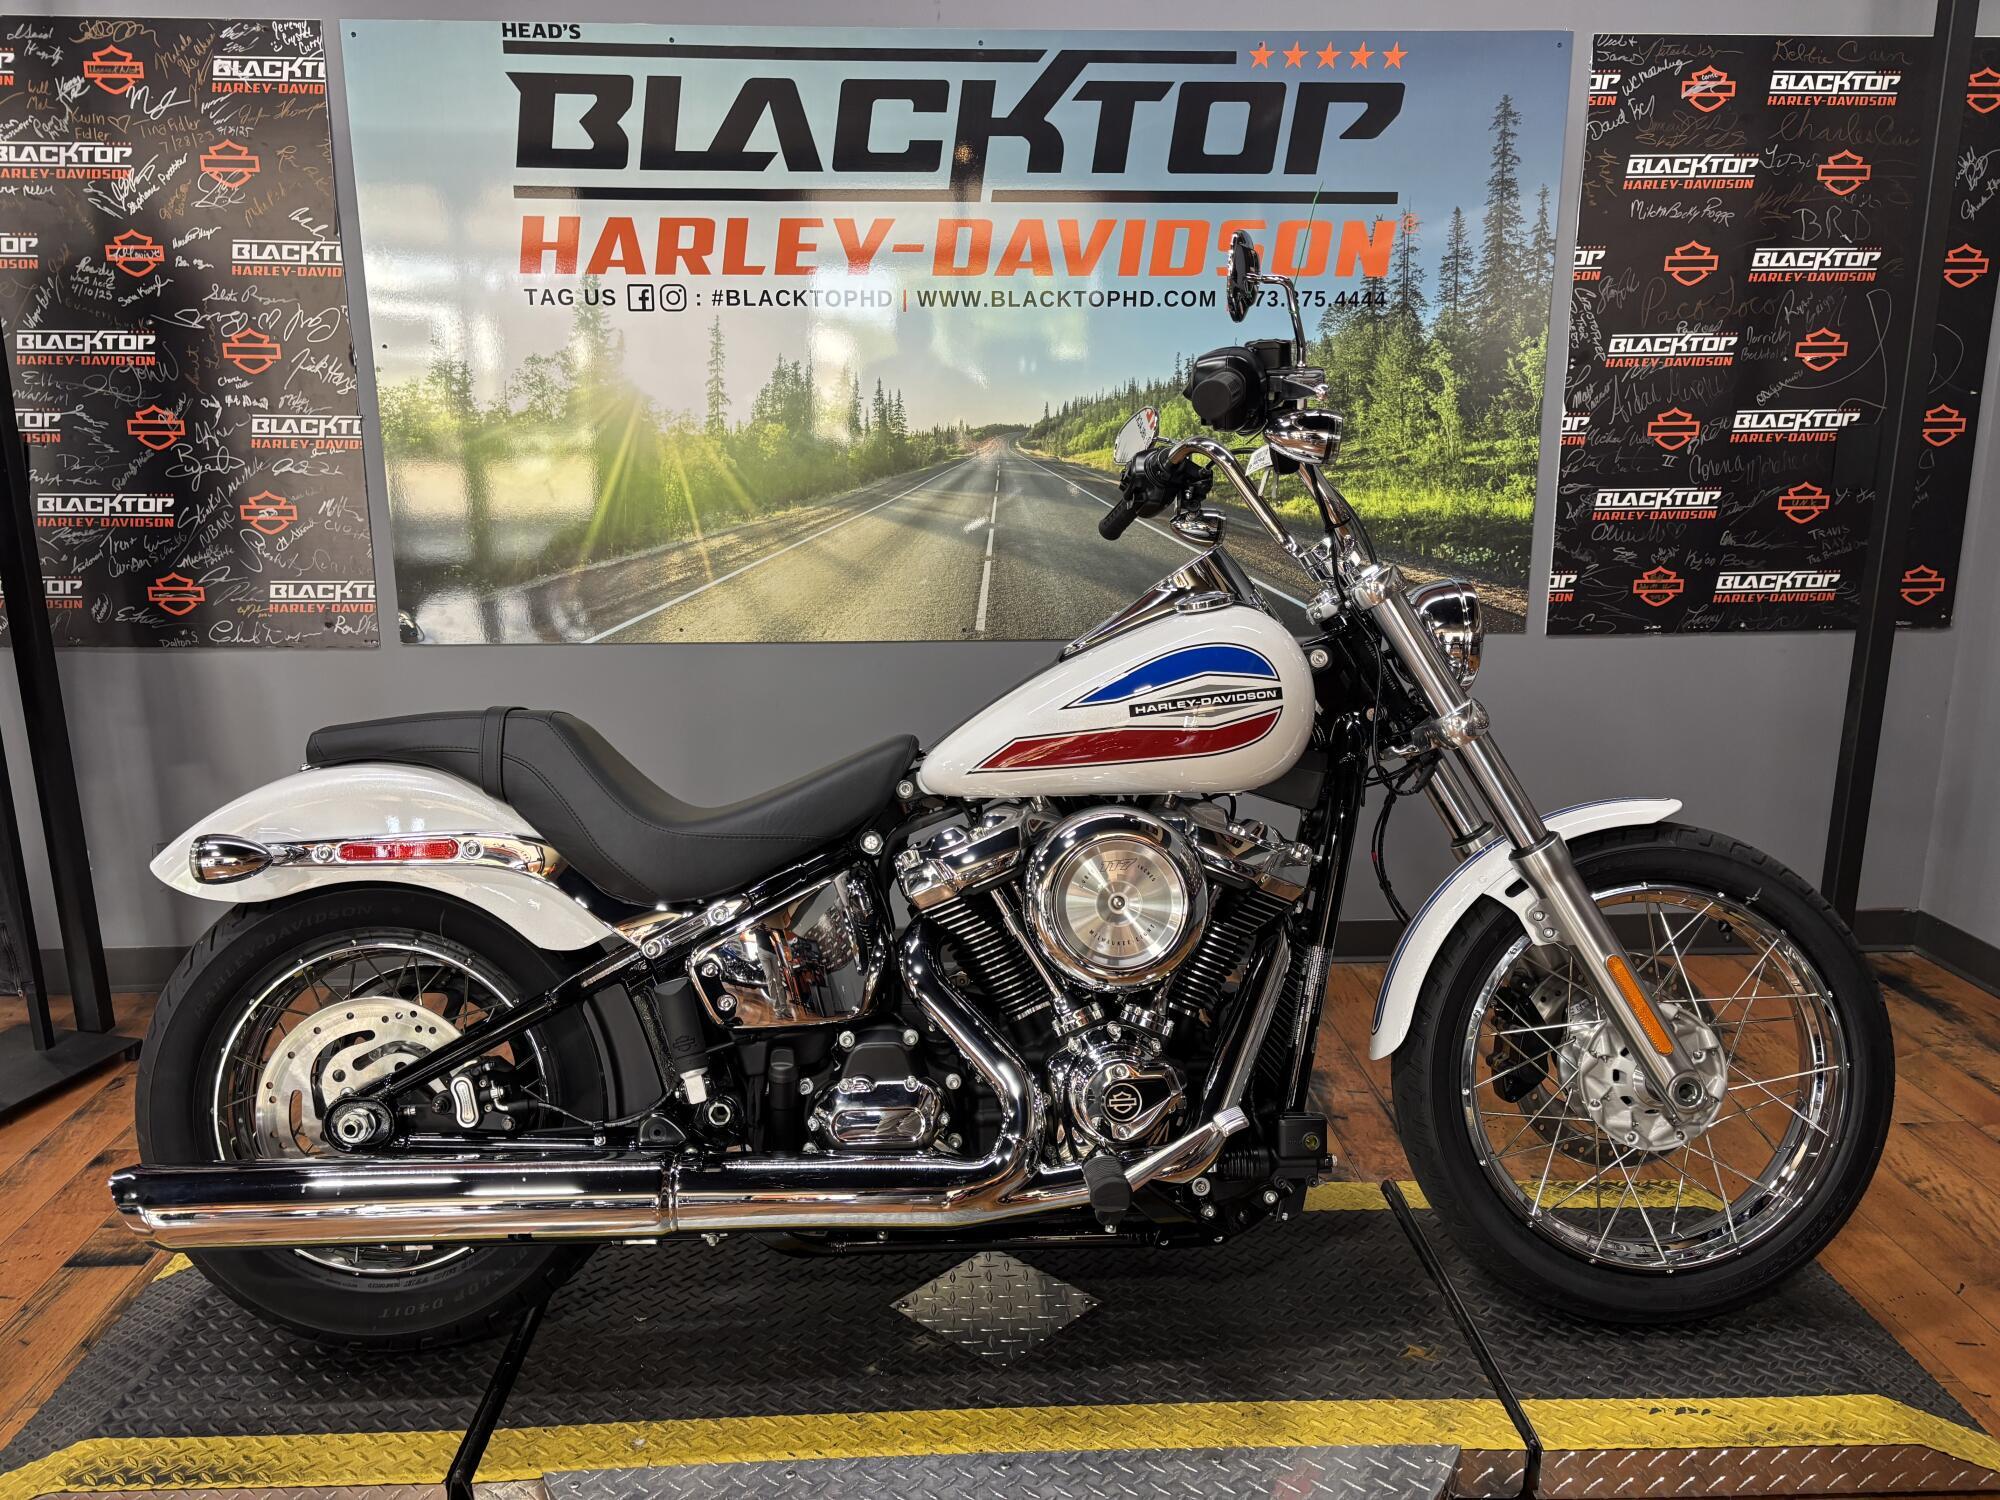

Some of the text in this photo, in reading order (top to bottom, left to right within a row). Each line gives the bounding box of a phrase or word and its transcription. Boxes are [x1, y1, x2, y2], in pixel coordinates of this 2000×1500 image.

[502, 22, 581, 40] HEAD'S
[212, 57, 326, 81] BLACKT
[1770, 71, 1901, 94] BLACKTOP
[1767, 96, 1897, 106] HARLEY-DAVIDSON
[505, 50, 1405, 202] BLACKTOP
[0, 169, 131, 180] ARLEY-DAVIDSON
[1626, 154, 1759, 177] BLACKTOP
[1623, 179, 1754, 190] HARLEY-DAVIDSON
[232, 241, 342, 265] BLACKT
[1752, 248, 1881, 271] BLACKTOP
[1748, 273, 1877, 283] HARLEY-DAVIDSON
[524, 289, 1387, 308] TAG US #BLACKTOPHD WWW.BLACKTOPHD.COM 73.75.4444
[17, 331, 155, 354] BLACKTOP
[1608, 334, 1738, 356] BLACKTOP
[17, 355, 155, 366] HARLEY-DAVIDSON
[1605, 357, 1733, 368] HARLEY-DAVIDSON
[1733, 410, 1860, 431] BLACKTOP
[252, 439, 361, 449] HARLEY-DAVID
[1730, 433, 1836, 443] HARLEY-DAVIDS
[37, 494, 174, 516] BLACKTOP
[1595, 488, 1721, 510] BLACKTOP
[37, 518, 174, 528] HARLEY-DAVIDSON
[1592, 511, 1717, 521] HARLEY-DAVIDSON
[1716, 571, 1840, 592] BLACKTOP
[1713, 593, 1836, 603] HARLEY-DAVIDSON
[1135, 690, 1277, 714] HARLEY-DAVIDSON
